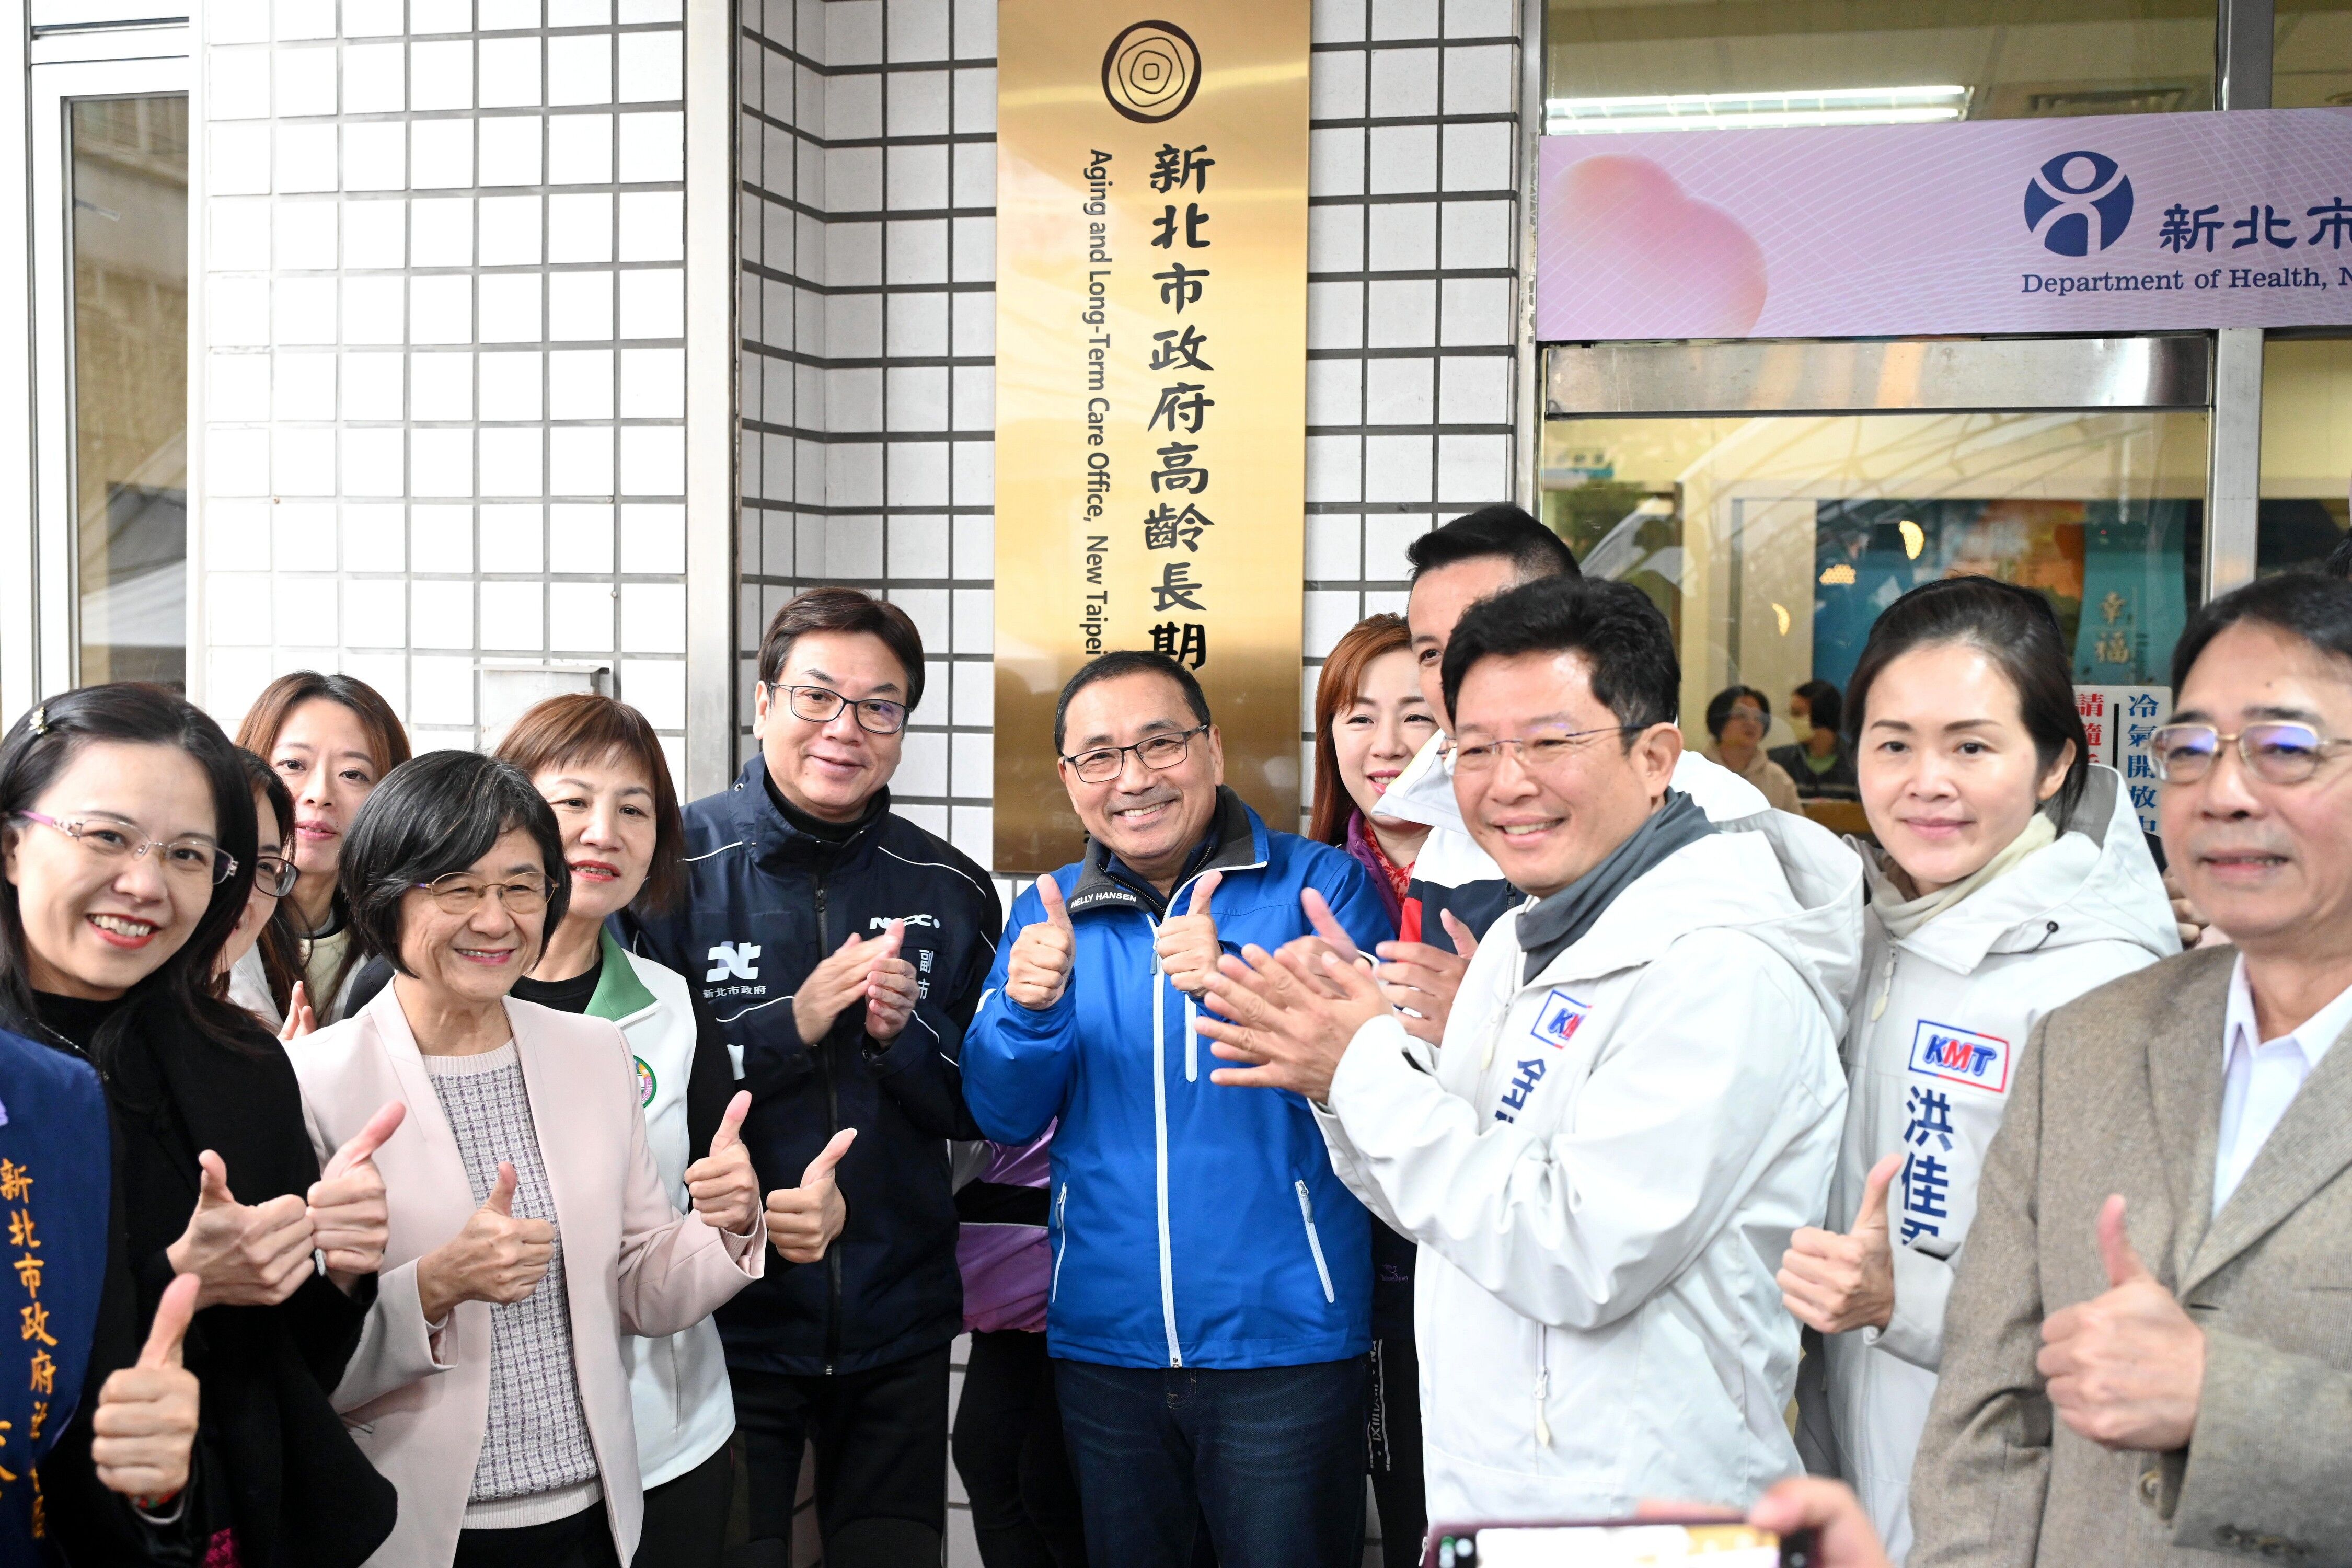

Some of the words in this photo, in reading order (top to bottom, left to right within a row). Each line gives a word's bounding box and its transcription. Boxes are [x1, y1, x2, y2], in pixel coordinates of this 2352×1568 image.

[1083, 148, 1112, 215] Aging
[1089, 222, 1112, 262] and
[2159, 197, 2352, 254] 新北市
[2021, 269, 2184, 296] Department
[2195, 269, 2222, 289] of
[2228, 267, 2327, 291] Health,
[1082, 270, 1111, 391] Long-Term
[1087, 397, 1110, 446] Care
[1143, 143, 1216, 671] 新北市政府高齡長期
[1083, 452, 1110, 522] Office,
[1086, 535, 1109, 585] New
[1079, 590, 1109, 655] Taipei
[1070, 894, 1094, 908] HELLY
[1096, 892, 1137, 903] HANSEN
[702, 985, 767, 999] 新北市政府
[1922, 1034, 1997, 1077] KMT
